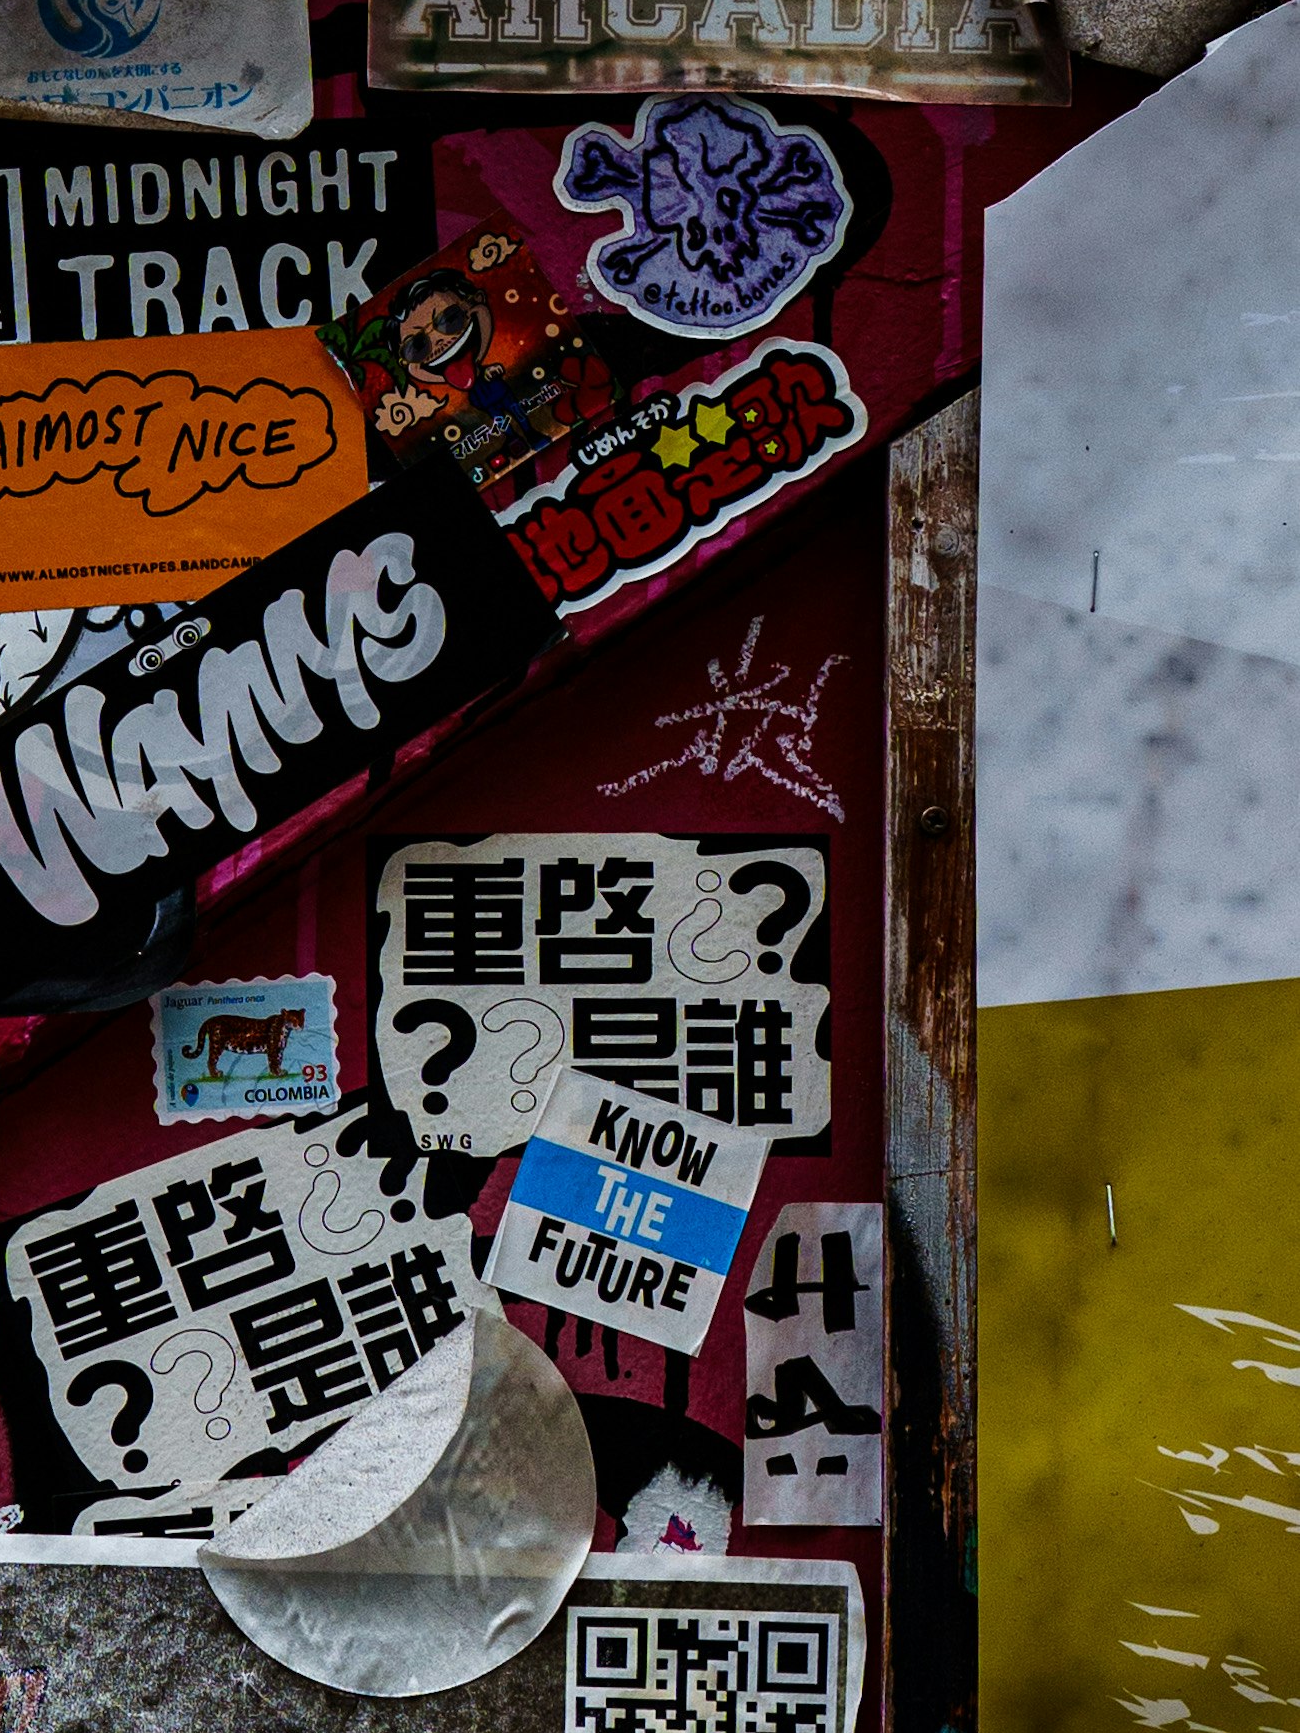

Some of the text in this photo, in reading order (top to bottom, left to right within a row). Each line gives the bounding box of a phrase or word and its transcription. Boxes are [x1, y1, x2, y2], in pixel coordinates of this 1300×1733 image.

[45, 147, 399, 229] MIDNIGHT
[57, 237, 381, 341] TRACK
[169, 418, 297, 473] NICE
[162, 992, 205, 1012] Jaguar
[244, 1082, 331, 1104] COLOMBIA
[302, 1064, 329, 1083] 93
[587, 1099, 718, 1187] KNOW
[597, 1164, 674, 1241] THE
[528, 1216, 698, 1313] FUTURE
